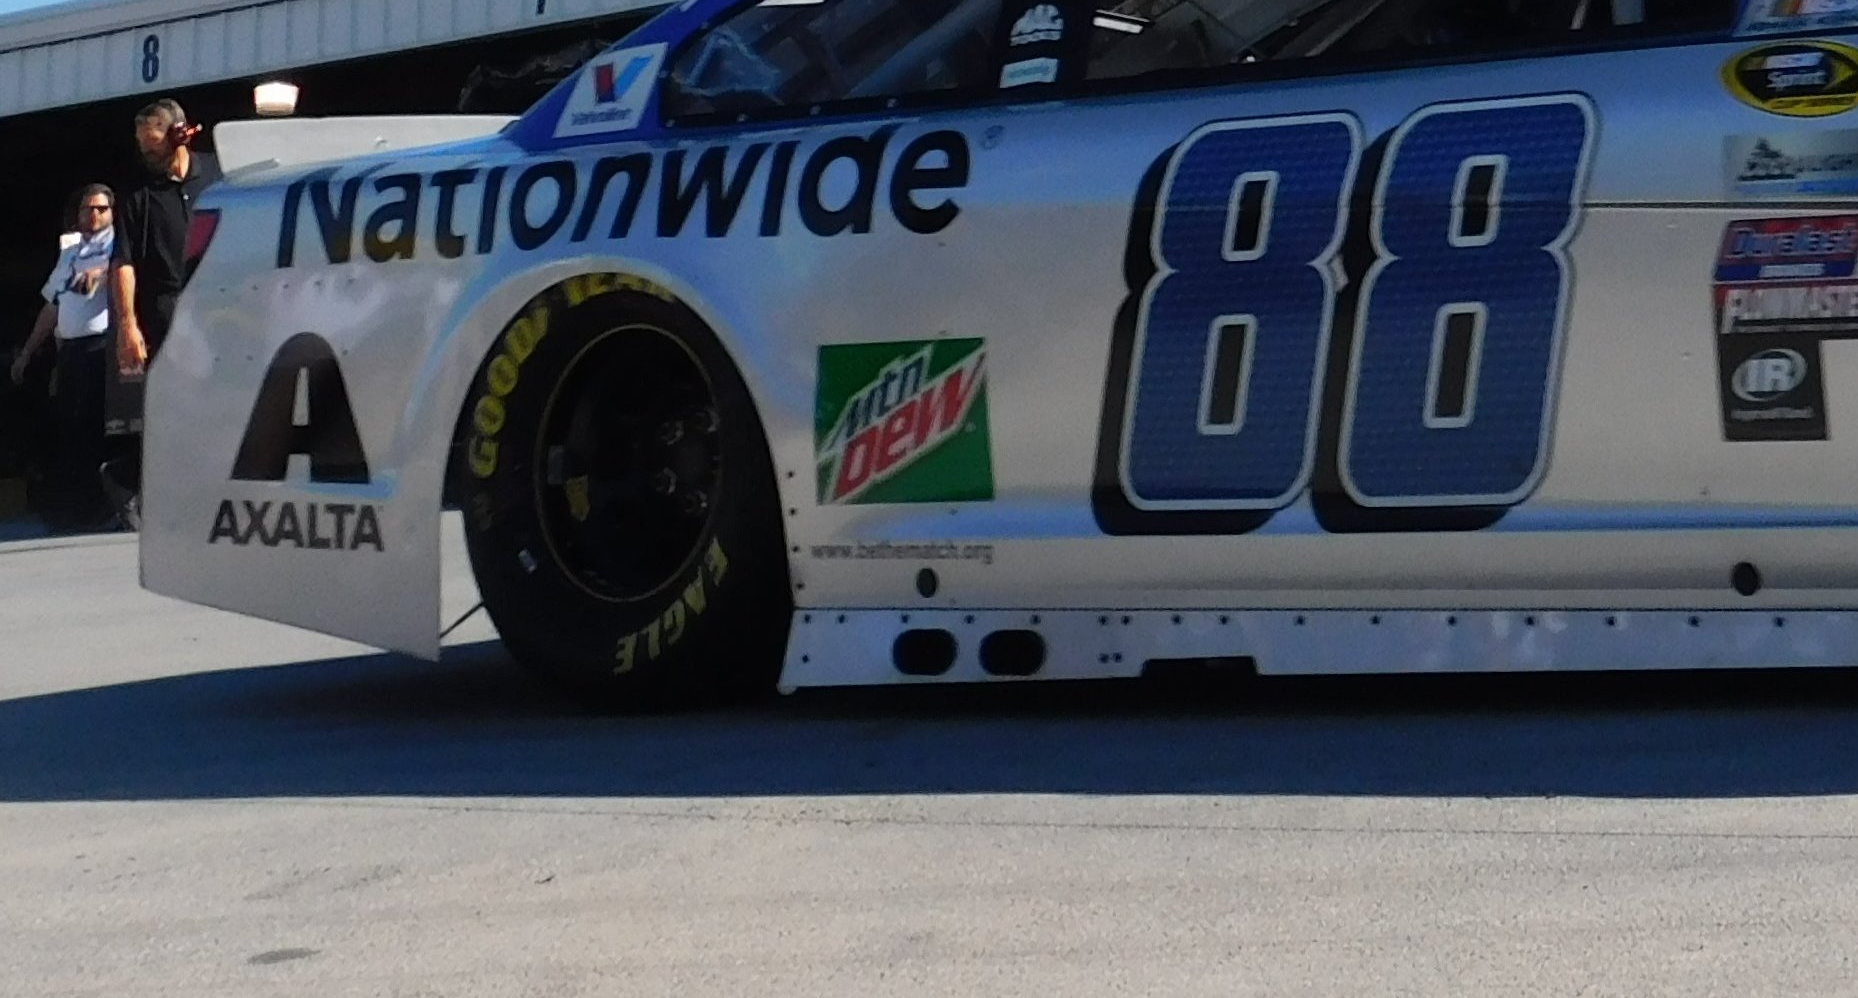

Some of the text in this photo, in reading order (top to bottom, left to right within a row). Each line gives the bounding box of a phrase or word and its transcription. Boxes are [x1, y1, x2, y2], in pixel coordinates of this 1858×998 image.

[141, 34, 160, 84] 8
[275, 126, 971, 269] Nationwide
[1095, 91, 1599, 533] 88
[1743, 357, 1794, 393] IR
[207, 499, 385, 552] AXALTA
[612, 534, 730, 677] EAGLE
